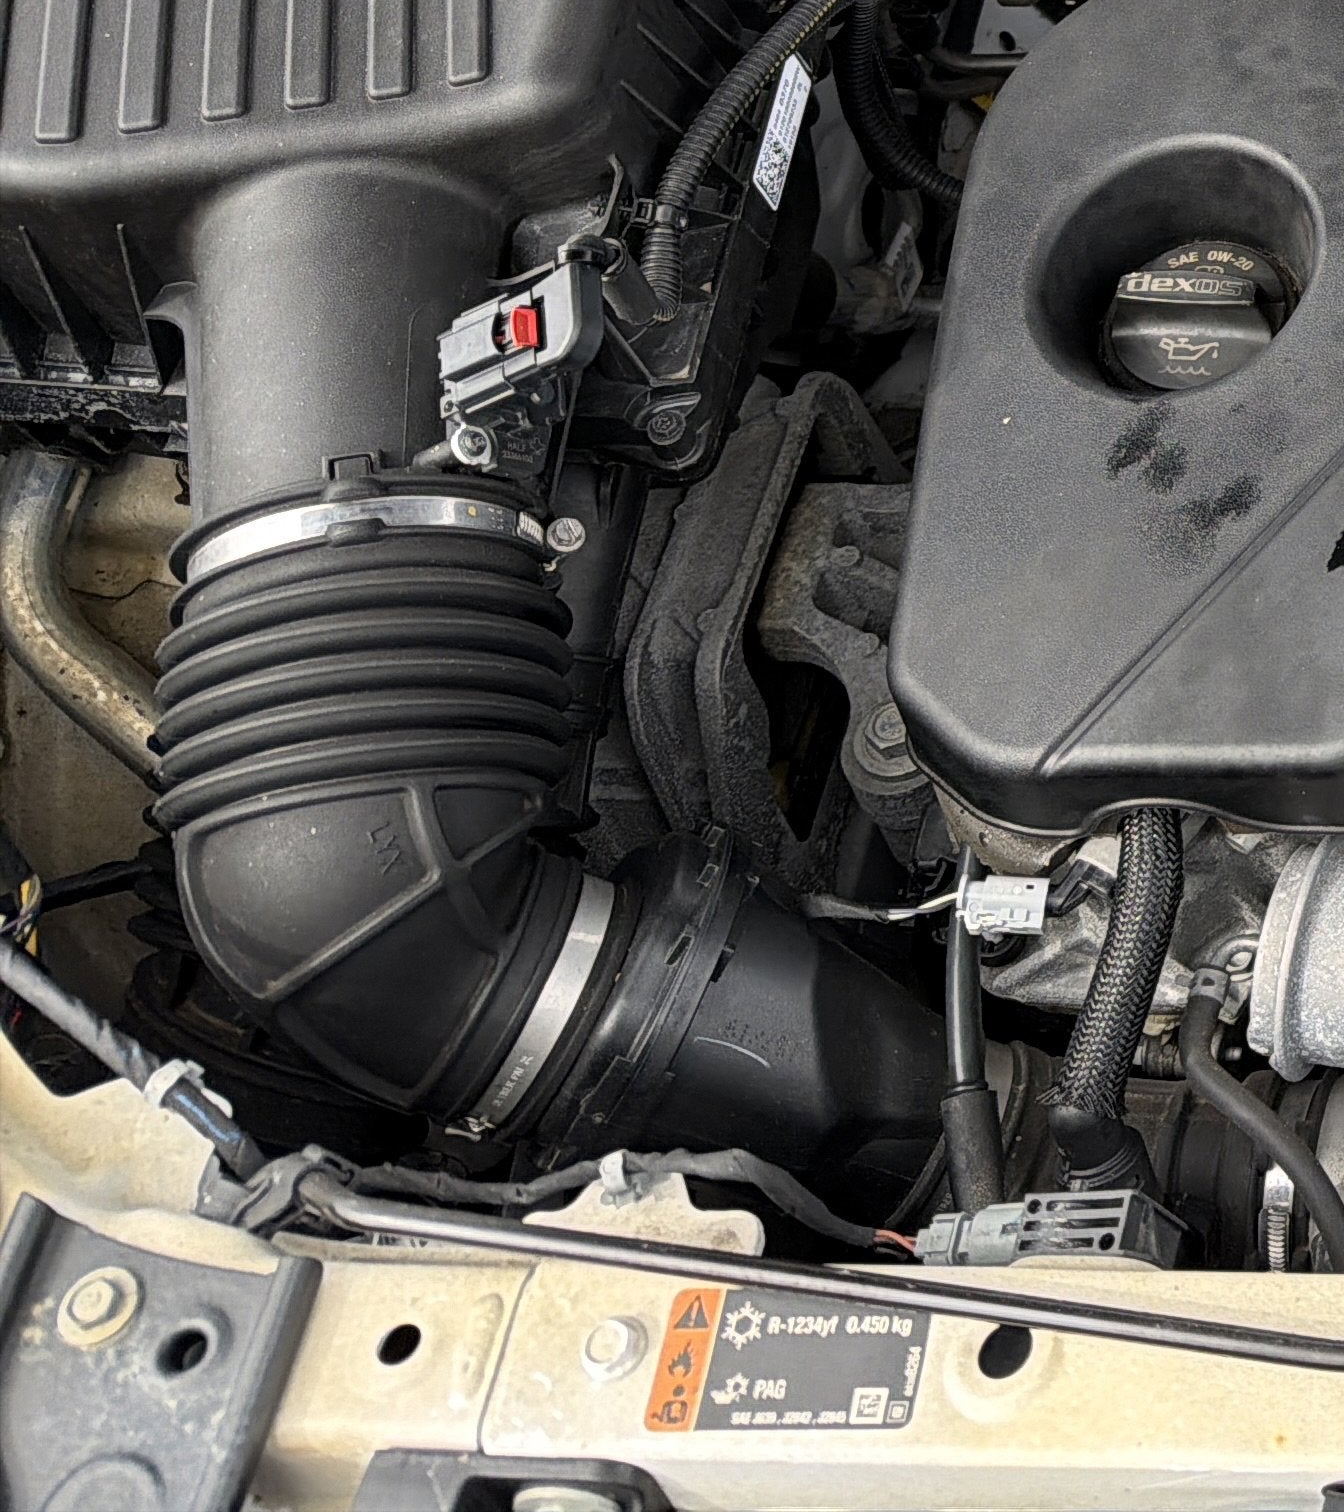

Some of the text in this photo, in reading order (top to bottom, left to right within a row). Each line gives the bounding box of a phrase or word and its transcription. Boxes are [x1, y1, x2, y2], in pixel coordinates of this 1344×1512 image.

[1168, 249, 1255, 273] SAE 0W-20
[1126, 273, 1245, 297] dexos
[767, 1315, 914, 1338] R-1234yf 0.450 kg
[752, 1378, 788, 1401] PAG
